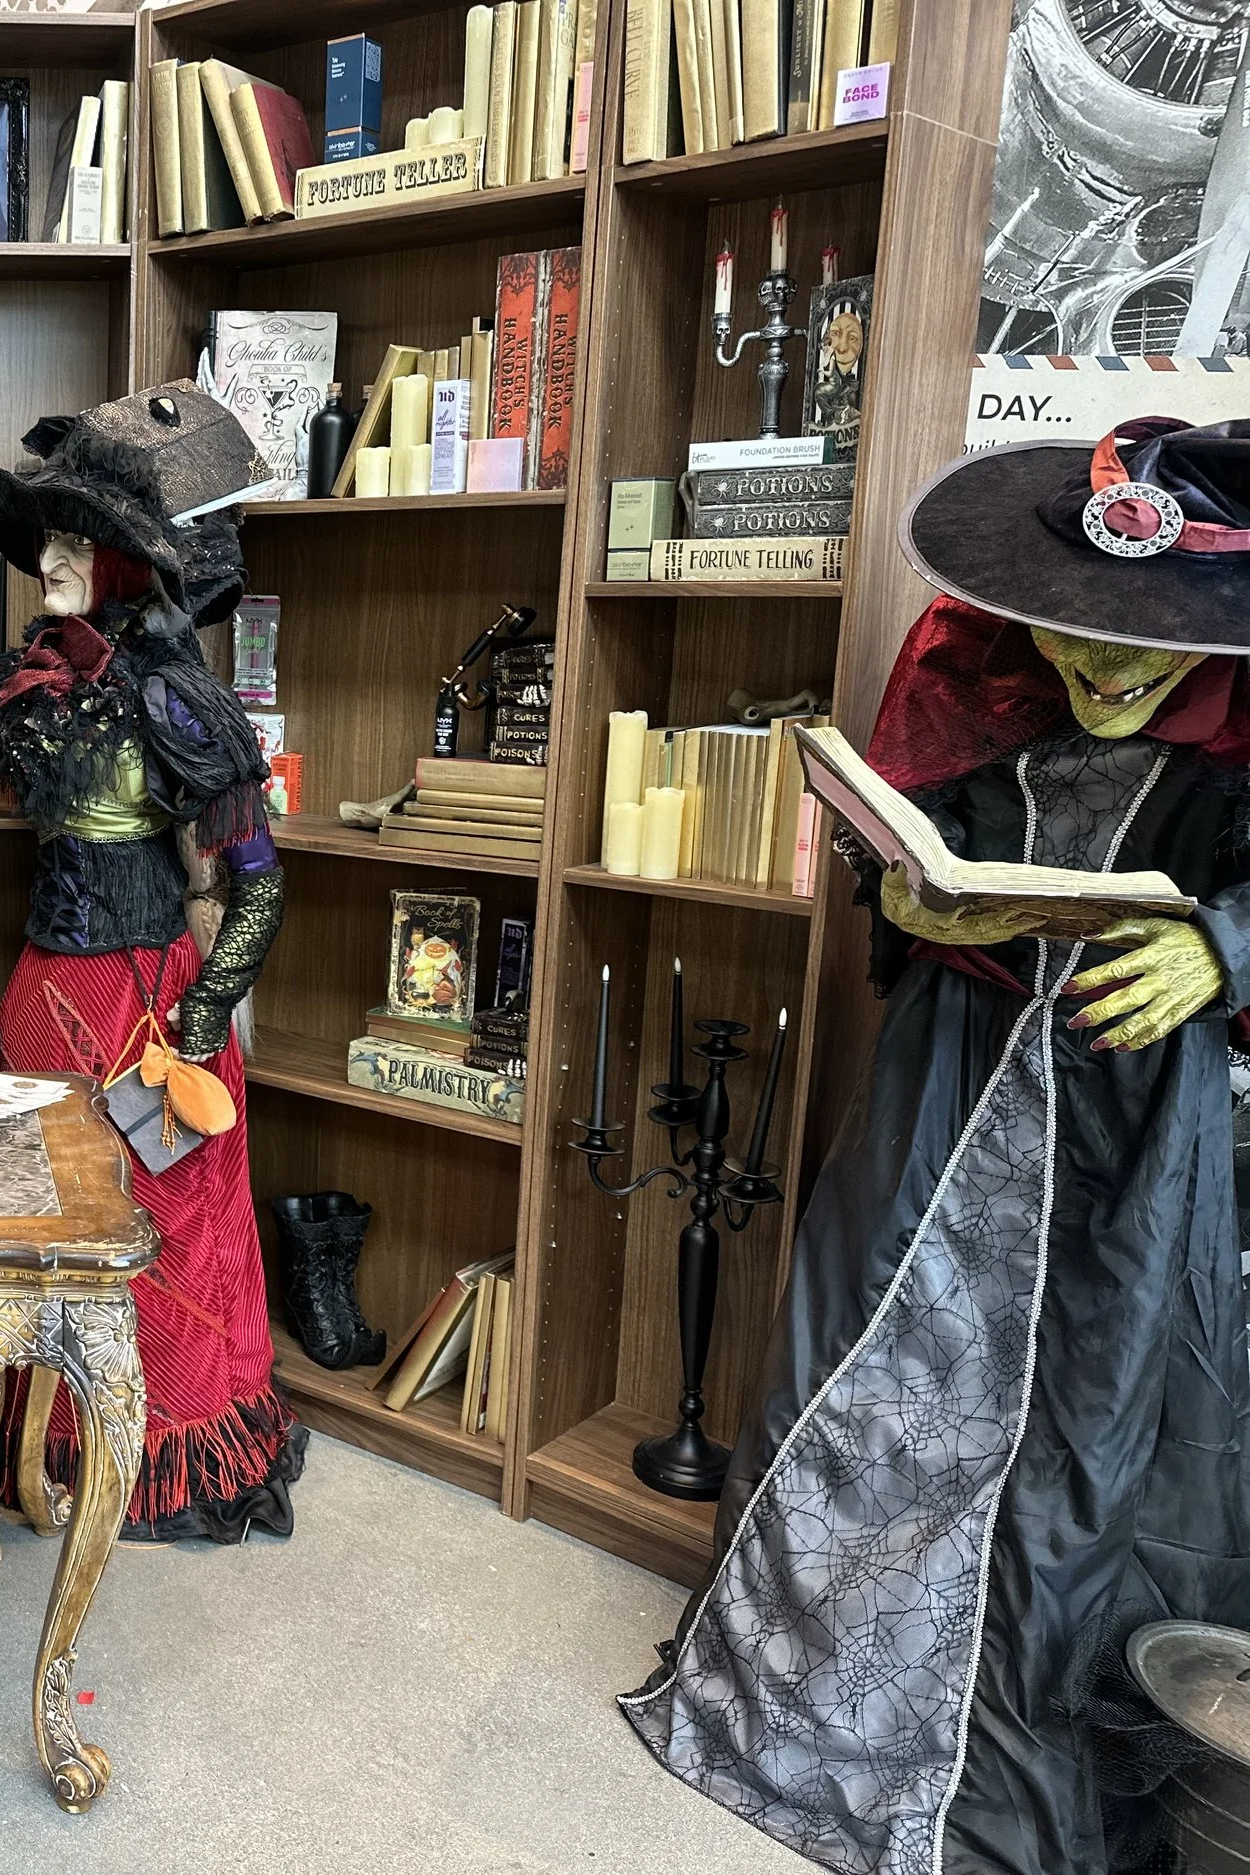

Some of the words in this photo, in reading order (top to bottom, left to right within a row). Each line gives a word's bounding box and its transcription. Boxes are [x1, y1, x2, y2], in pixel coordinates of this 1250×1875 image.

[625, 48, 642, 99] CURVE
[842, 91, 880, 104] BOND
[845, 83, 879, 97] FACE
[307, 169, 386, 207] FORTUNE
[394, 152, 467, 191] TELLER
[225, 338, 284, 368] Ghoulia
[283, 341, 329, 364] Child's
[263, 365, 281, 373] BOOK
[499, 317, 517, 432] HANDBOOK
[513, 336, 529, 409] WITCH'S
[548, 313, 568, 430] HANDBOOK
[563, 335, 577, 408] WITCHS
[977, 393, 1072, 423] DAY...
[262, 440, 297, 467] kling
[739, 446, 792, 456] FOUNDATION
[793, 444, 821, 453] BRUSH
[736, 474, 834, 497] POTIONS
[733, 509, 831, 532] POTIONS
[689, 549, 751, 570] FORTUNE
[757, 548, 815, 570] TELLING
[246, 616, 263, 625] NYX
[241, 635, 266, 648] JUMBO
[437, 717, 453, 725] NYX
[513, 713, 546, 723] CURES
[507, 731, 548, 740] POTIONS
[495, 748, 539, 759] POISONS
[411, 905, 445, 918] Book
[446, 905, 456, 917] of
[427, 916, 464, 931] Spells
[487, 1025, 517, 1037] CURES
[480, 1040, 519, 1054] POTIONS
[468, 1055, 509, 1070] POISONS
[388, 1056, 493, 1106] PALMISTRY
